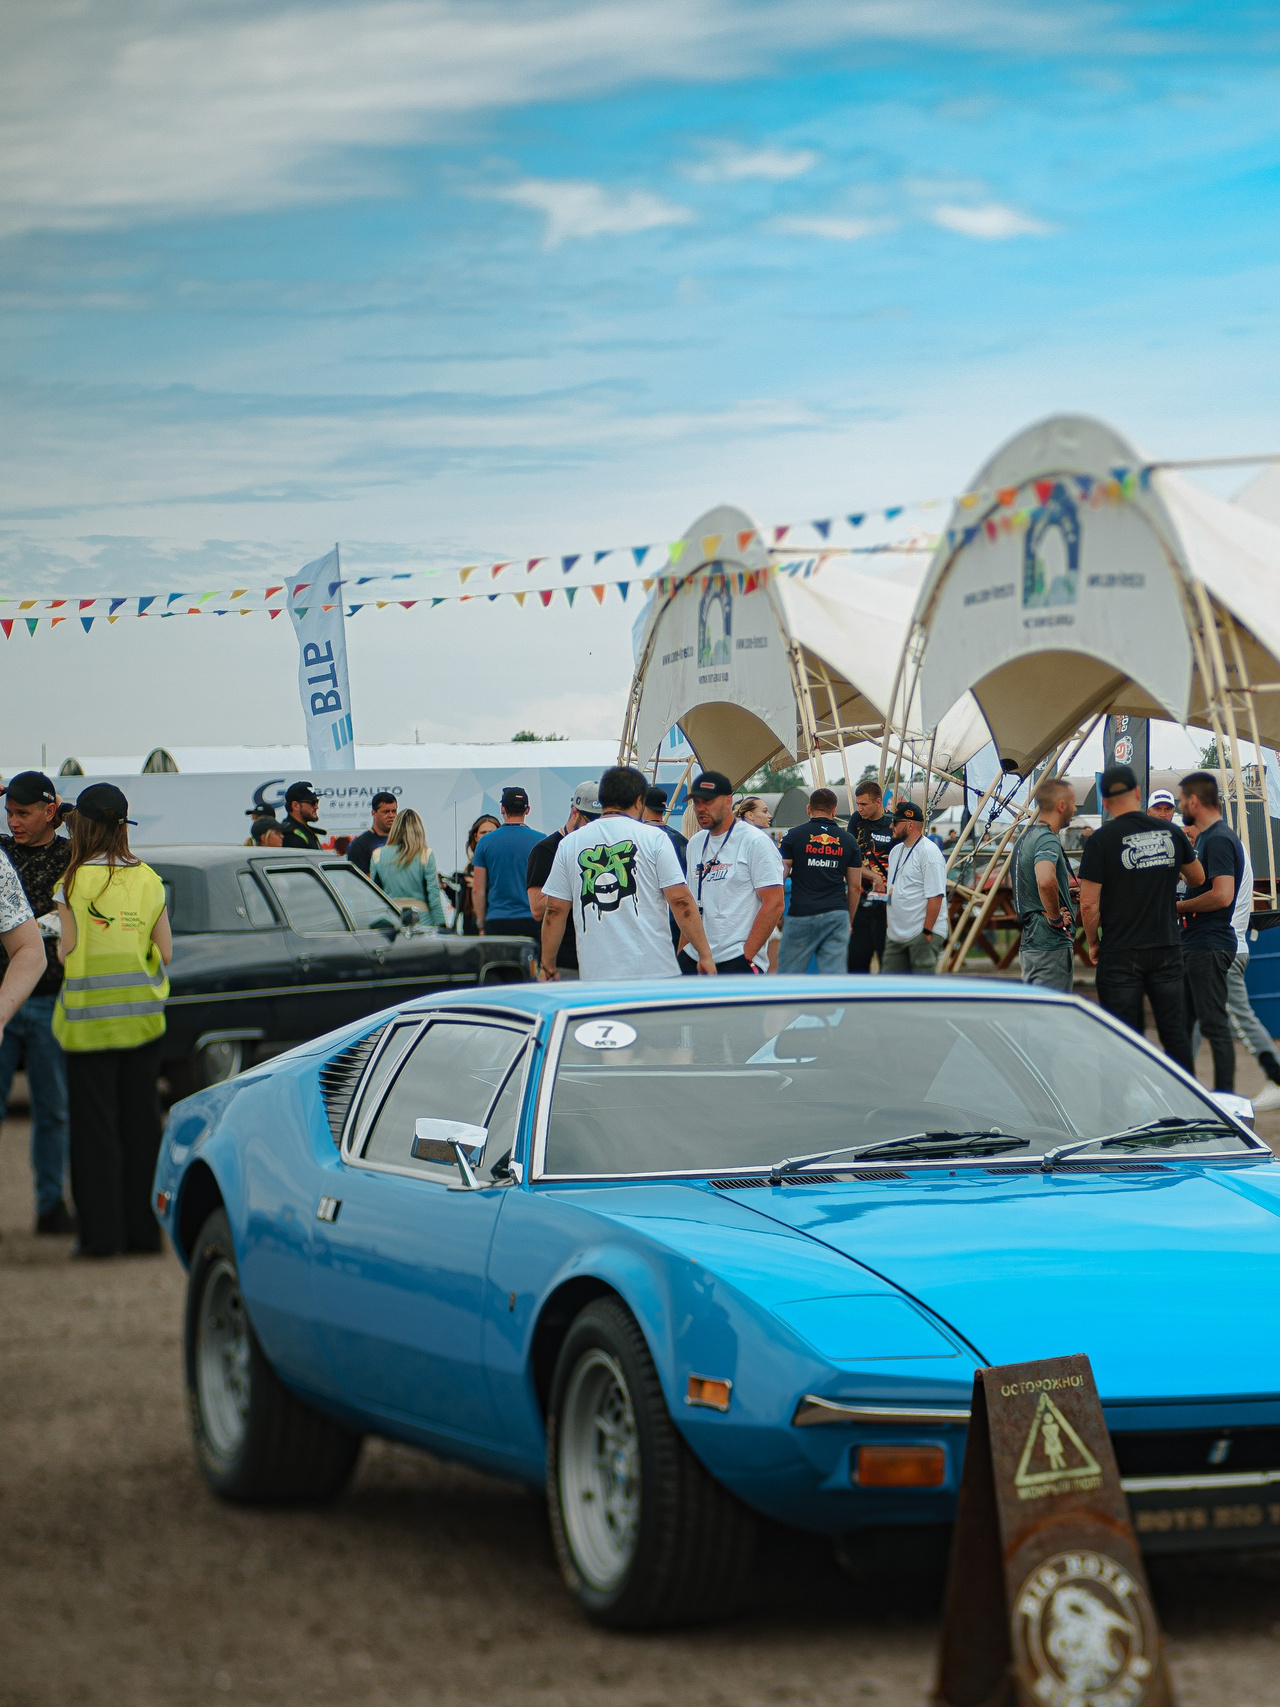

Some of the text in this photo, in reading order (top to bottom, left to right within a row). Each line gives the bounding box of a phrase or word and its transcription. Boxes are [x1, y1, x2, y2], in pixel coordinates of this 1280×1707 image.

[805, 844, 843, 857] Red Bull
[807, 858, 830, 868] Mobil
[1136, 858, 1175, 869] HUMMER
[597, 1026, 614, 1038] 7
[1001, 1375, 1085, 1397] ОСТОРОЖНО!
